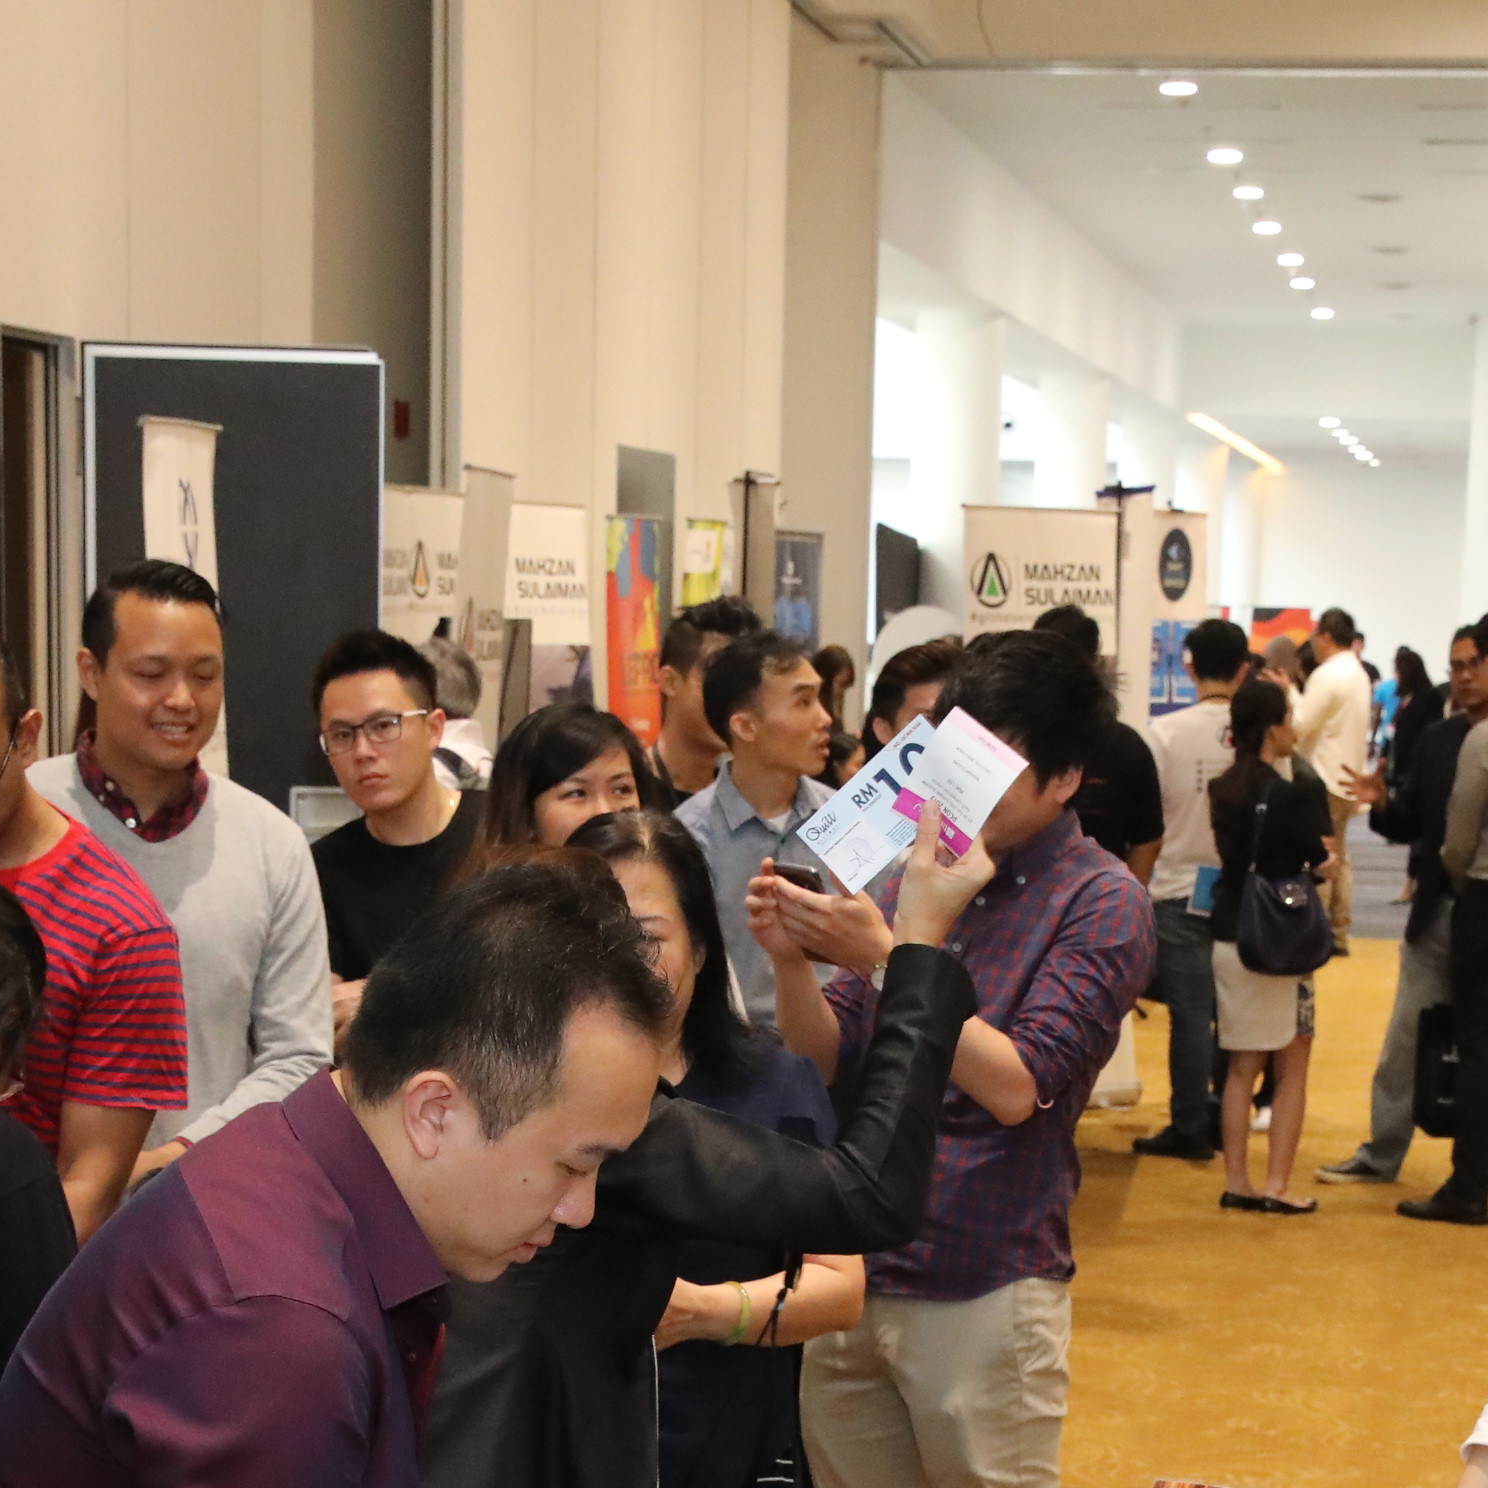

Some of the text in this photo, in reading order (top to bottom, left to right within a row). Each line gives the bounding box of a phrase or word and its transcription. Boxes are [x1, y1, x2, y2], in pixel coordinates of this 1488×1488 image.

[1024, 563, 1101, 582] MAHZAN
[1025, 588, 1114, 606] SULAIMAN
[851, 782, 879, 809] RM
[805, 811, 838, 842] Quill
